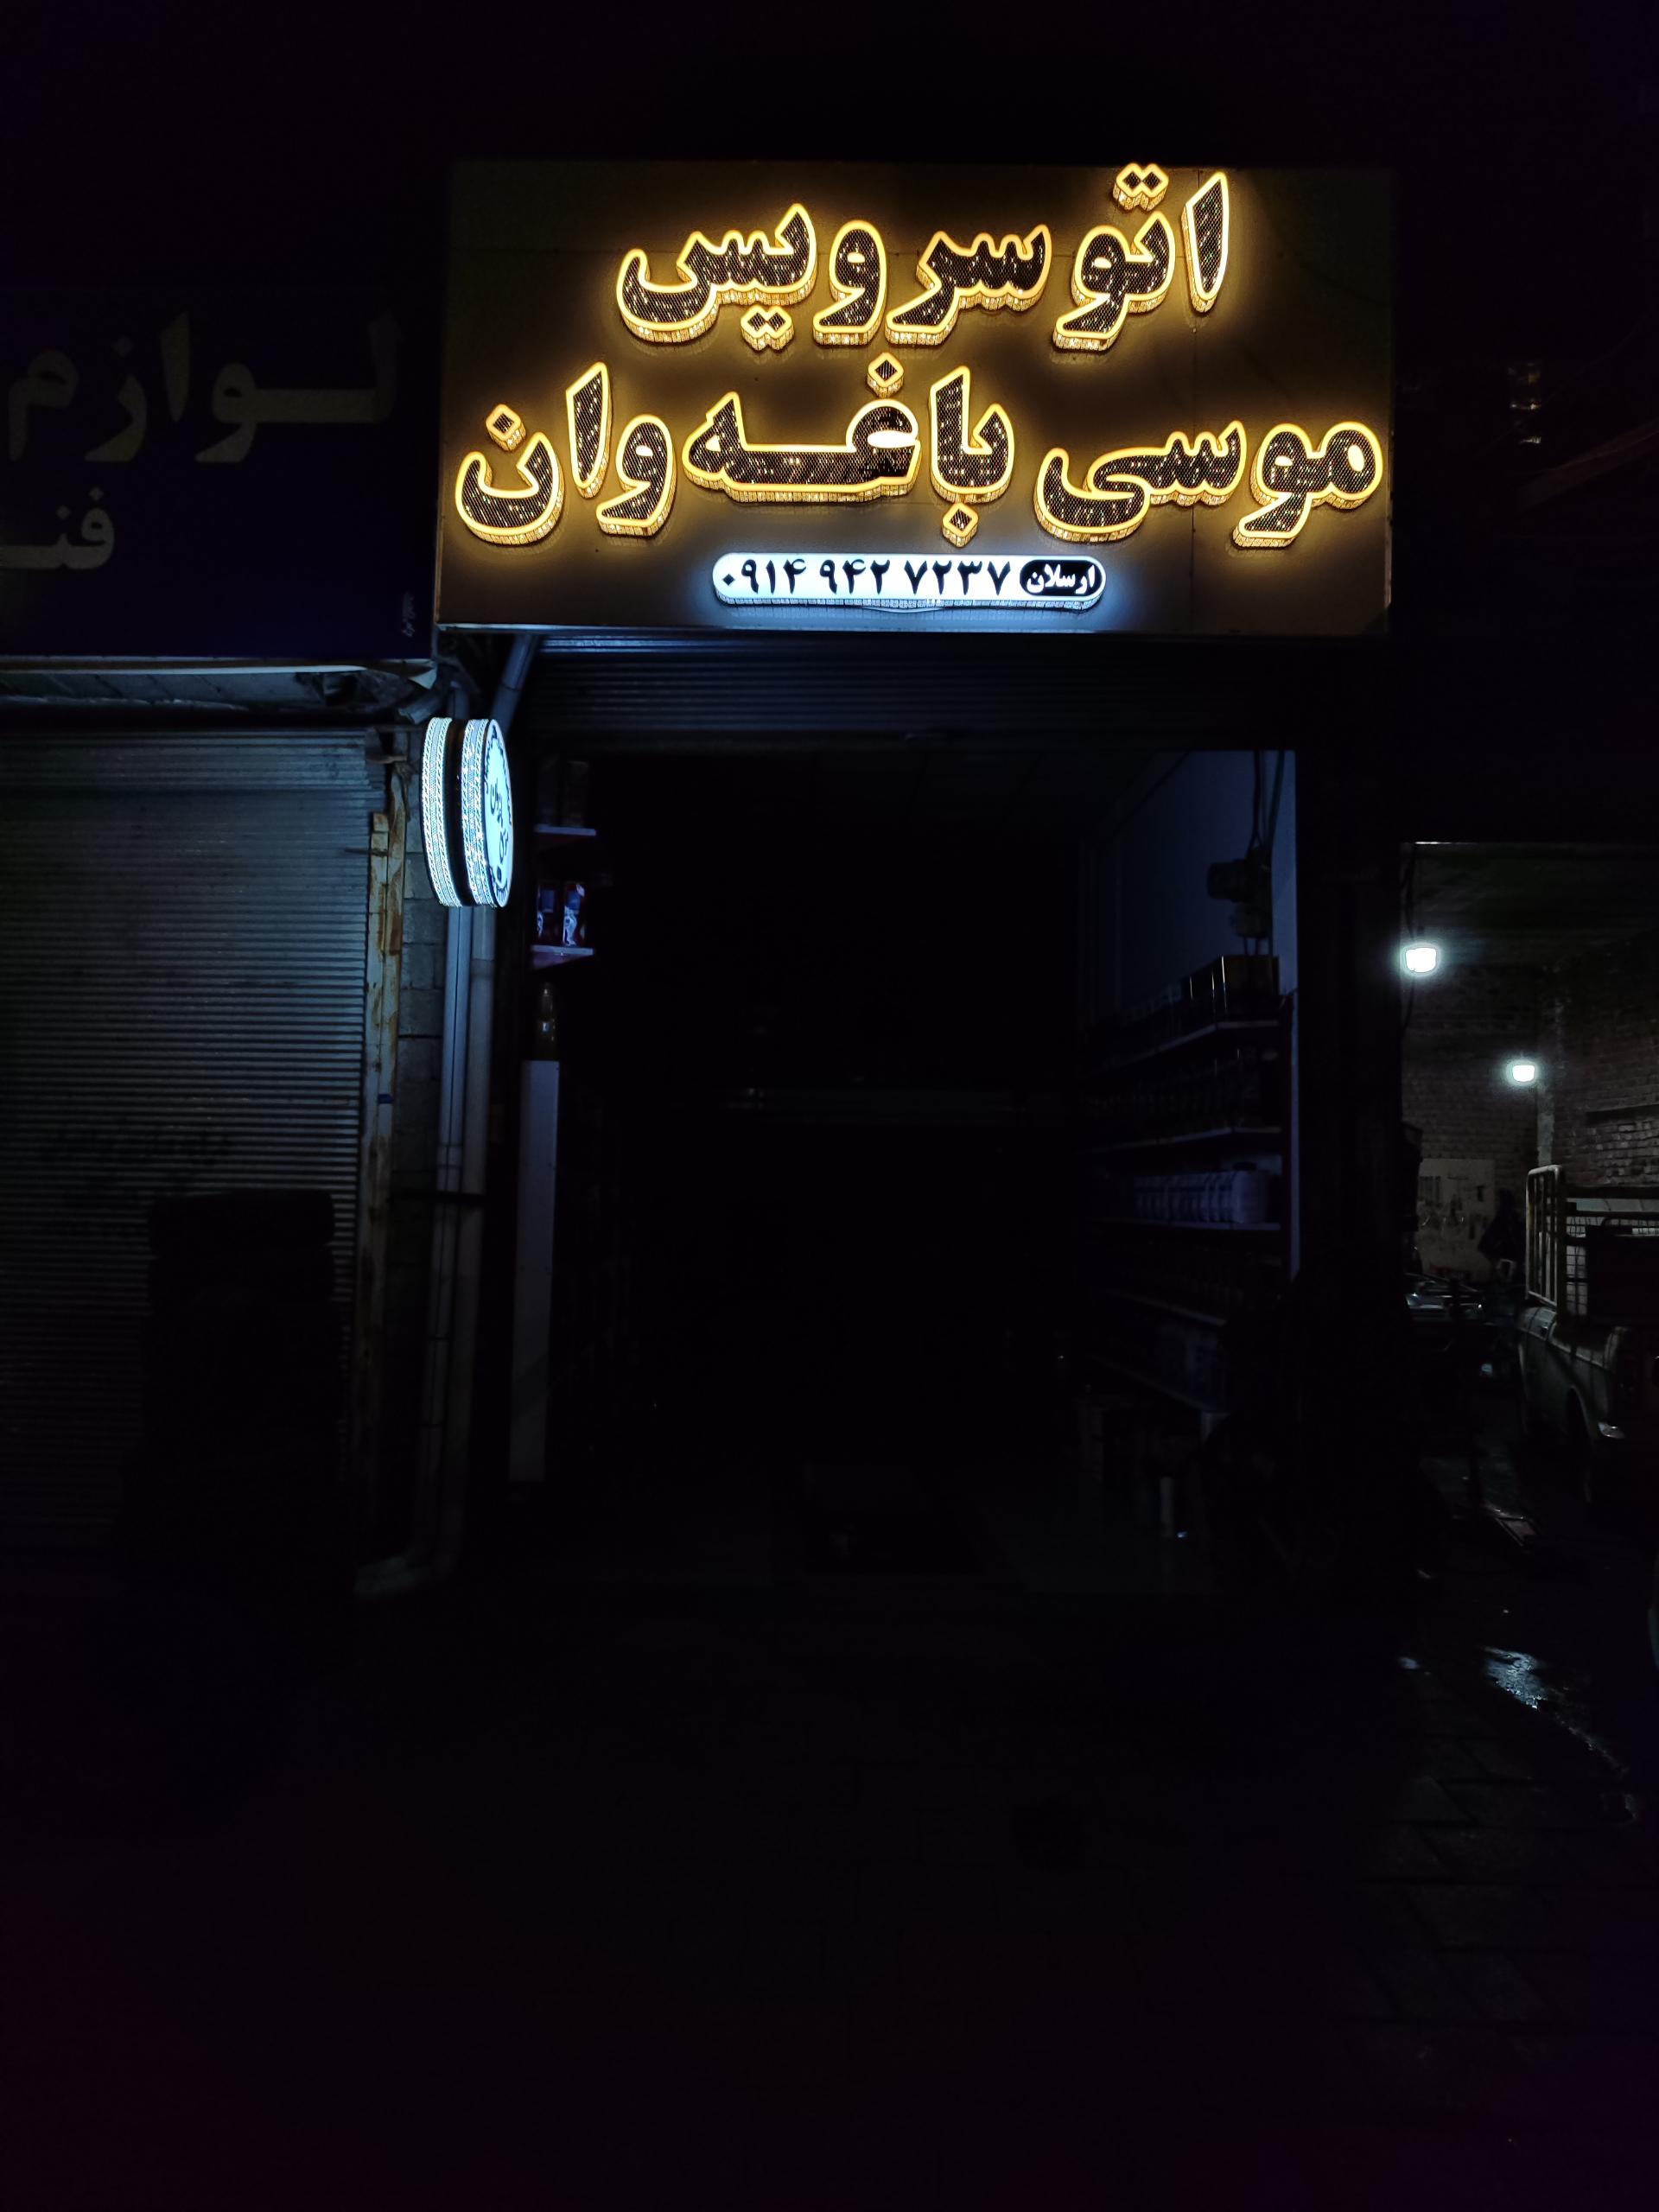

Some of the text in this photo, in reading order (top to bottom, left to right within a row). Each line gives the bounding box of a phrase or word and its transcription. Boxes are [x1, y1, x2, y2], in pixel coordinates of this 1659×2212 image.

[614, 203, 1052, 349] سرویس
[1033, 420, 1384, 549] موسی
[1026, 563, 1096, 595] ارسلان
